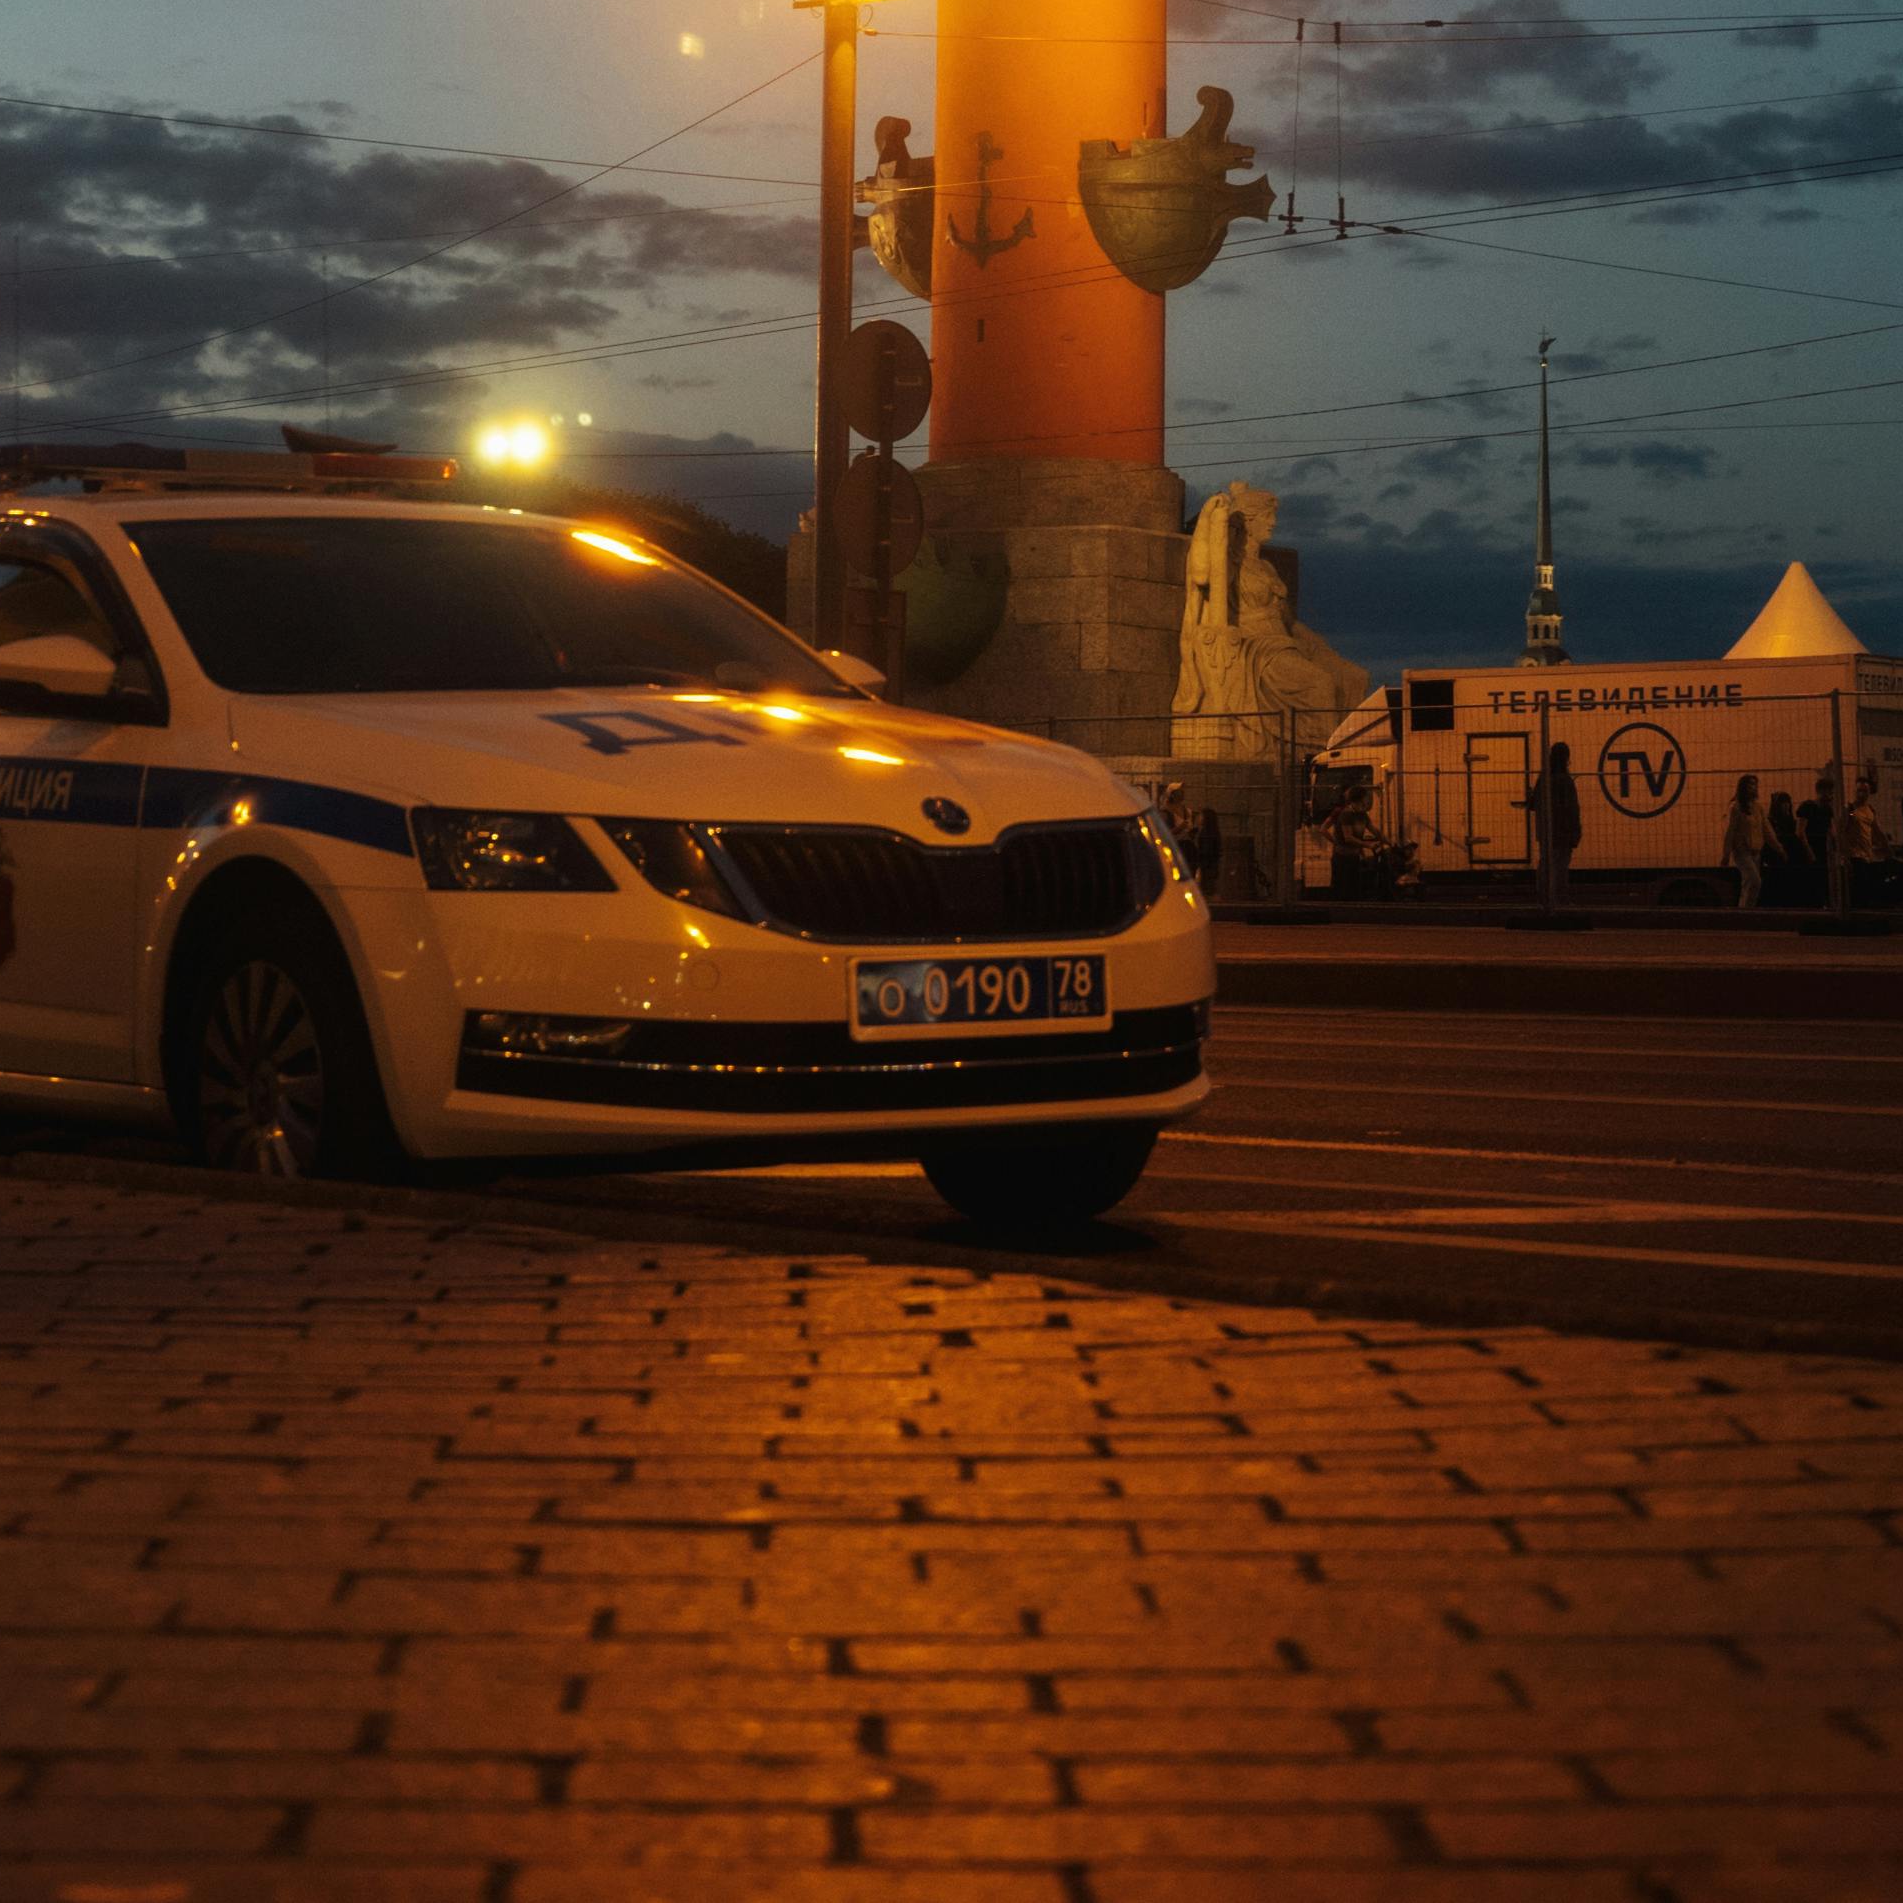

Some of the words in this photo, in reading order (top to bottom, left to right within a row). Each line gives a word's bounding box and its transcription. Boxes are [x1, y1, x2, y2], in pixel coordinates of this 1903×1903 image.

[1488, 684, 1743, 714] ТЕЛЕВИДЕНИЕ
[1607, 750, 1674, 798] TV
[924, 963, 1031, 1017] 0190
[1053, 960, 1093, 998] 78
[1059, 999, 1090, 1014] RUS
